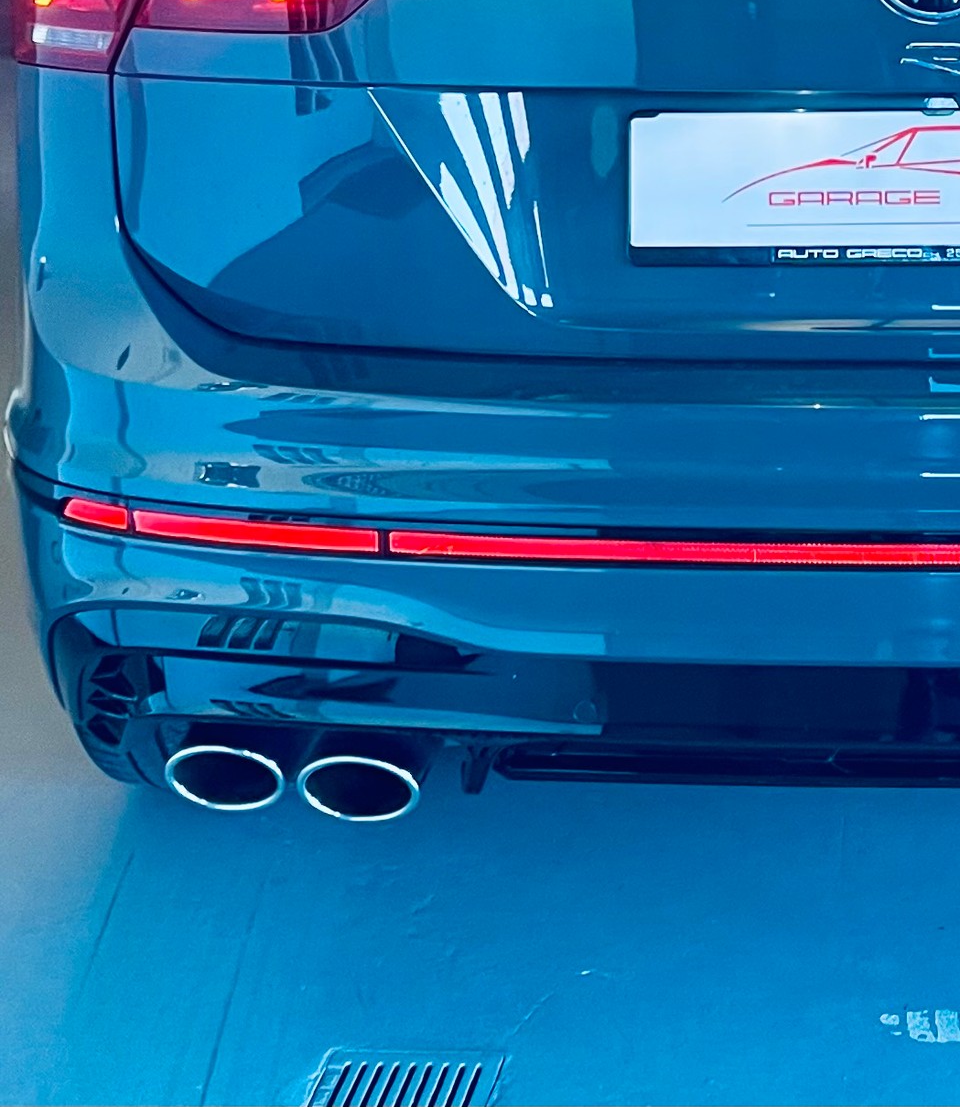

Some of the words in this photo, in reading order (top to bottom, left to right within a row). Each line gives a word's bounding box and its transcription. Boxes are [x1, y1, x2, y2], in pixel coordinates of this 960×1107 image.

[768, 190, 940, 207] GARAGE
[777, 248, 839, 259] AUTO
[846, 248, 922, 258] GRECO
